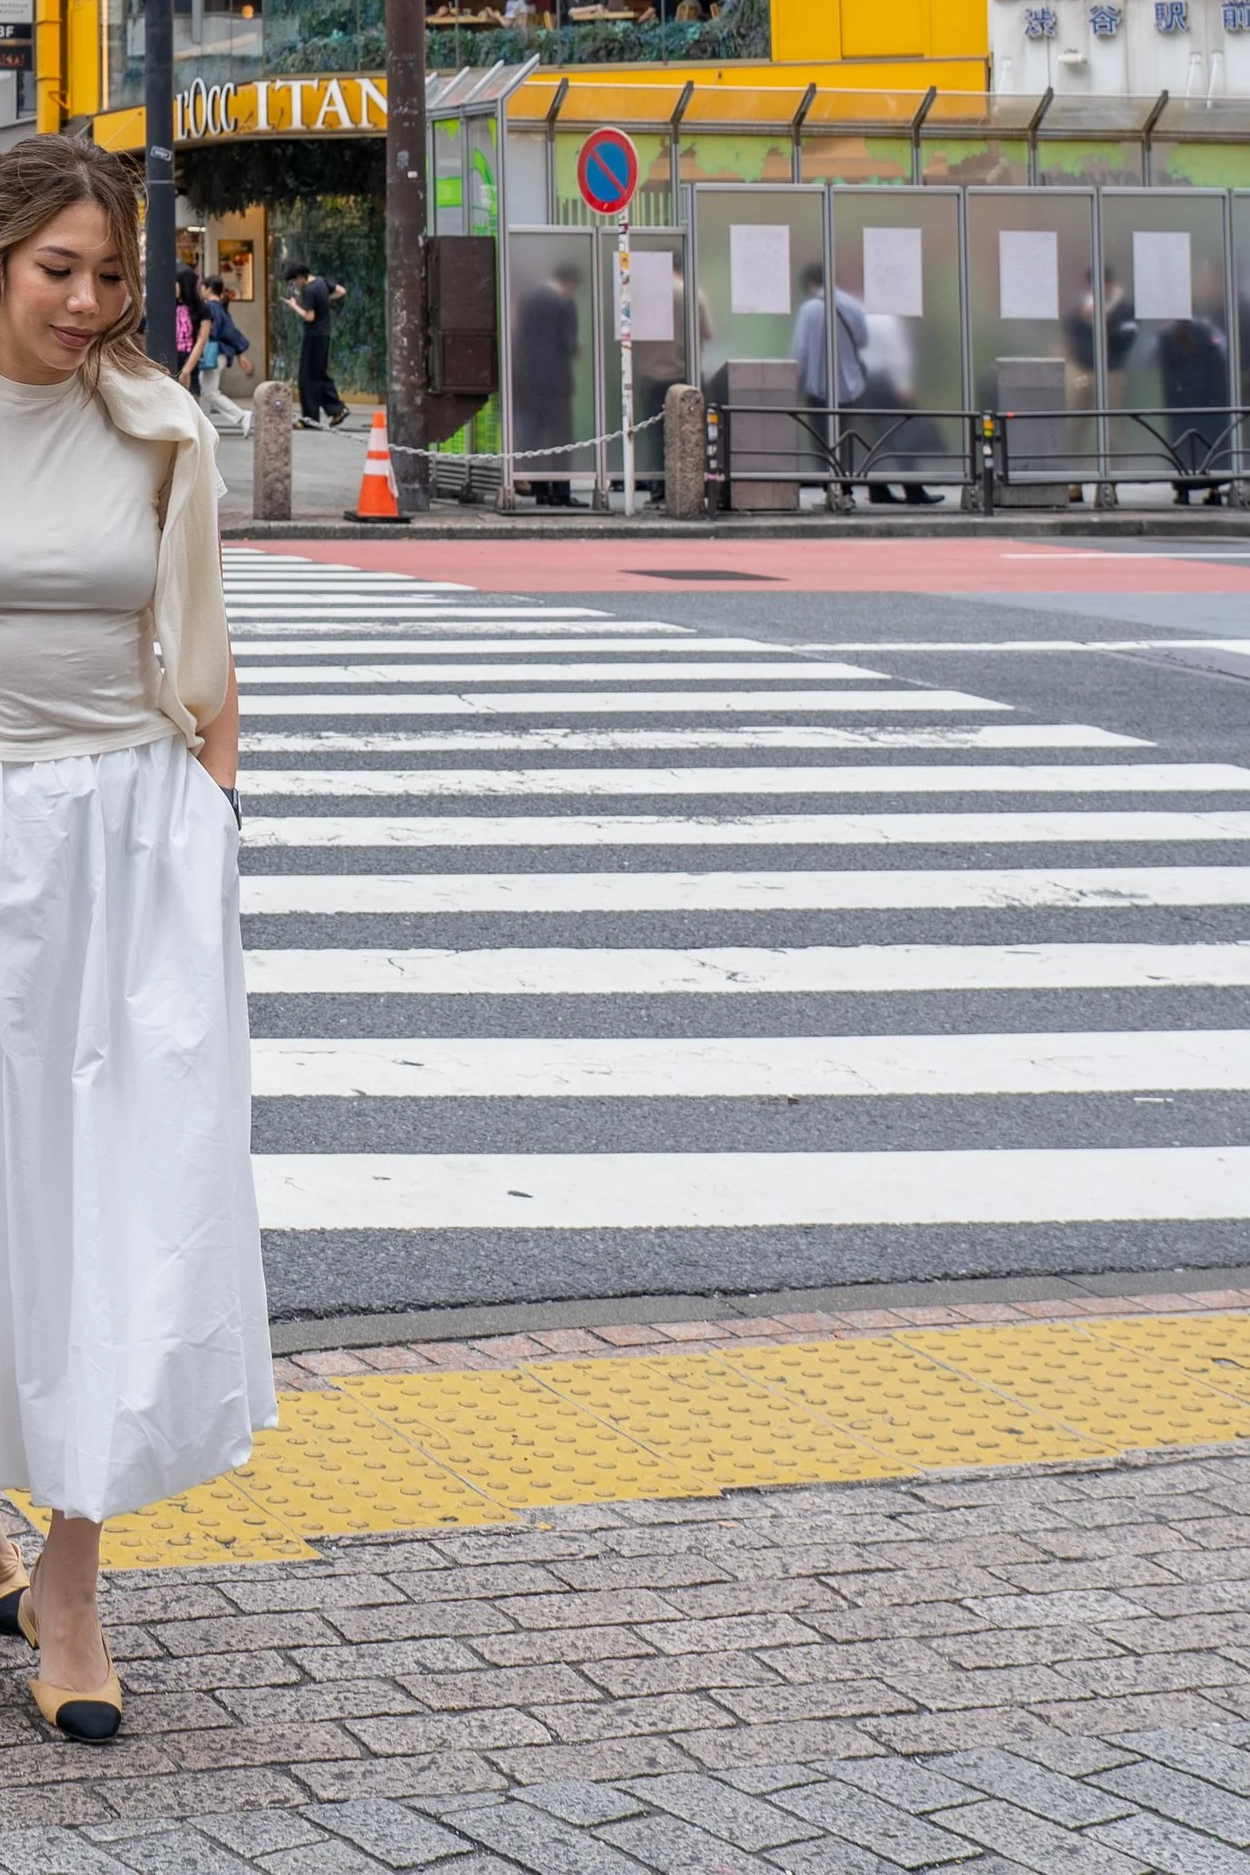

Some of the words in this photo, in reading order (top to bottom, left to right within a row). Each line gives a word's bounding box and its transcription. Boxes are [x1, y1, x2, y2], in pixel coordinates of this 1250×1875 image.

[1023, 0, 1250, 38] 渋谷駅前
[176, 77, 387, 140] L'OCCITAN
